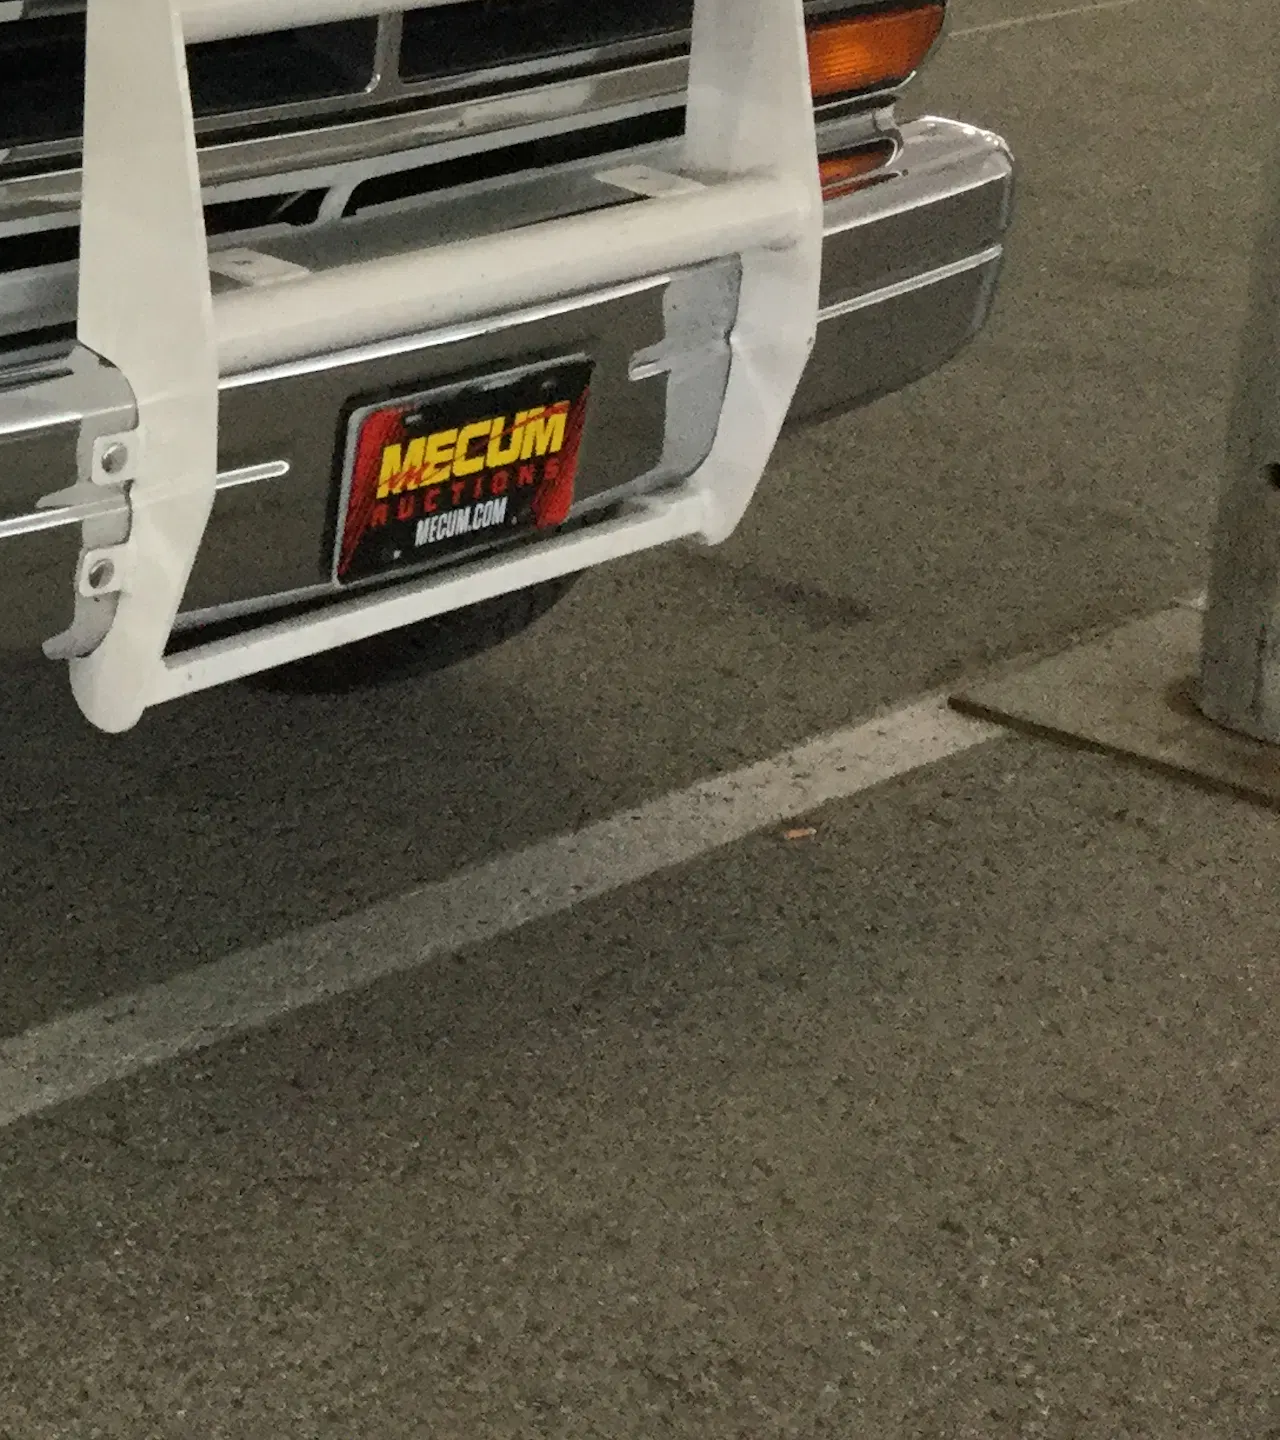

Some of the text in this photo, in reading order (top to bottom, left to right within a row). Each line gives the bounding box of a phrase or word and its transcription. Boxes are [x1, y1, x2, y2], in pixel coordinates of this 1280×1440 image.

[376, 400, 571, 499] MECUM
[371, 458, 561, 528] AUCTIONS
[414, 496, 509, 547] MECUM.COM
